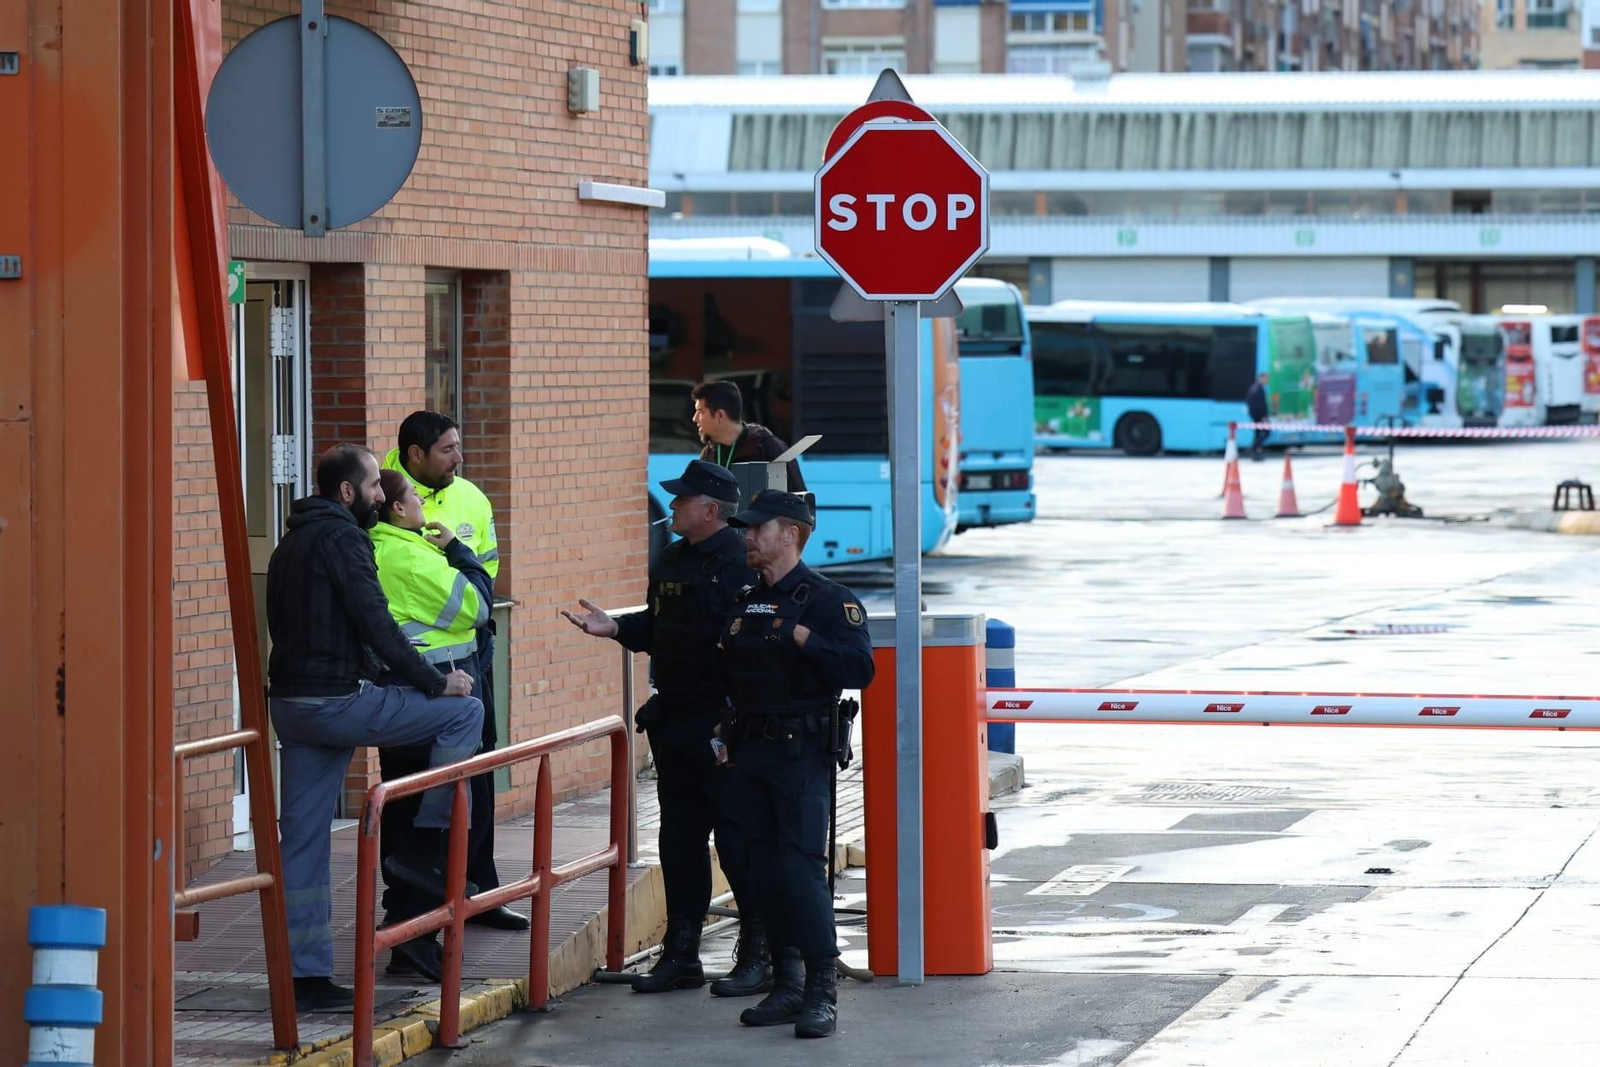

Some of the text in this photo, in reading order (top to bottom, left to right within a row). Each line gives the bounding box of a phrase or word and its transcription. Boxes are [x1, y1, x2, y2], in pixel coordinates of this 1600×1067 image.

[827, 193, 975, 231] STOP
[1005, 701, 1020, 709] Nice
[1216, 704, 1232, 712] Nice
[1323, 706, 1339, 714] Nice
[1432, 708, 1448, 716] Nice
[1542, 710, 1558, 718] Nice
